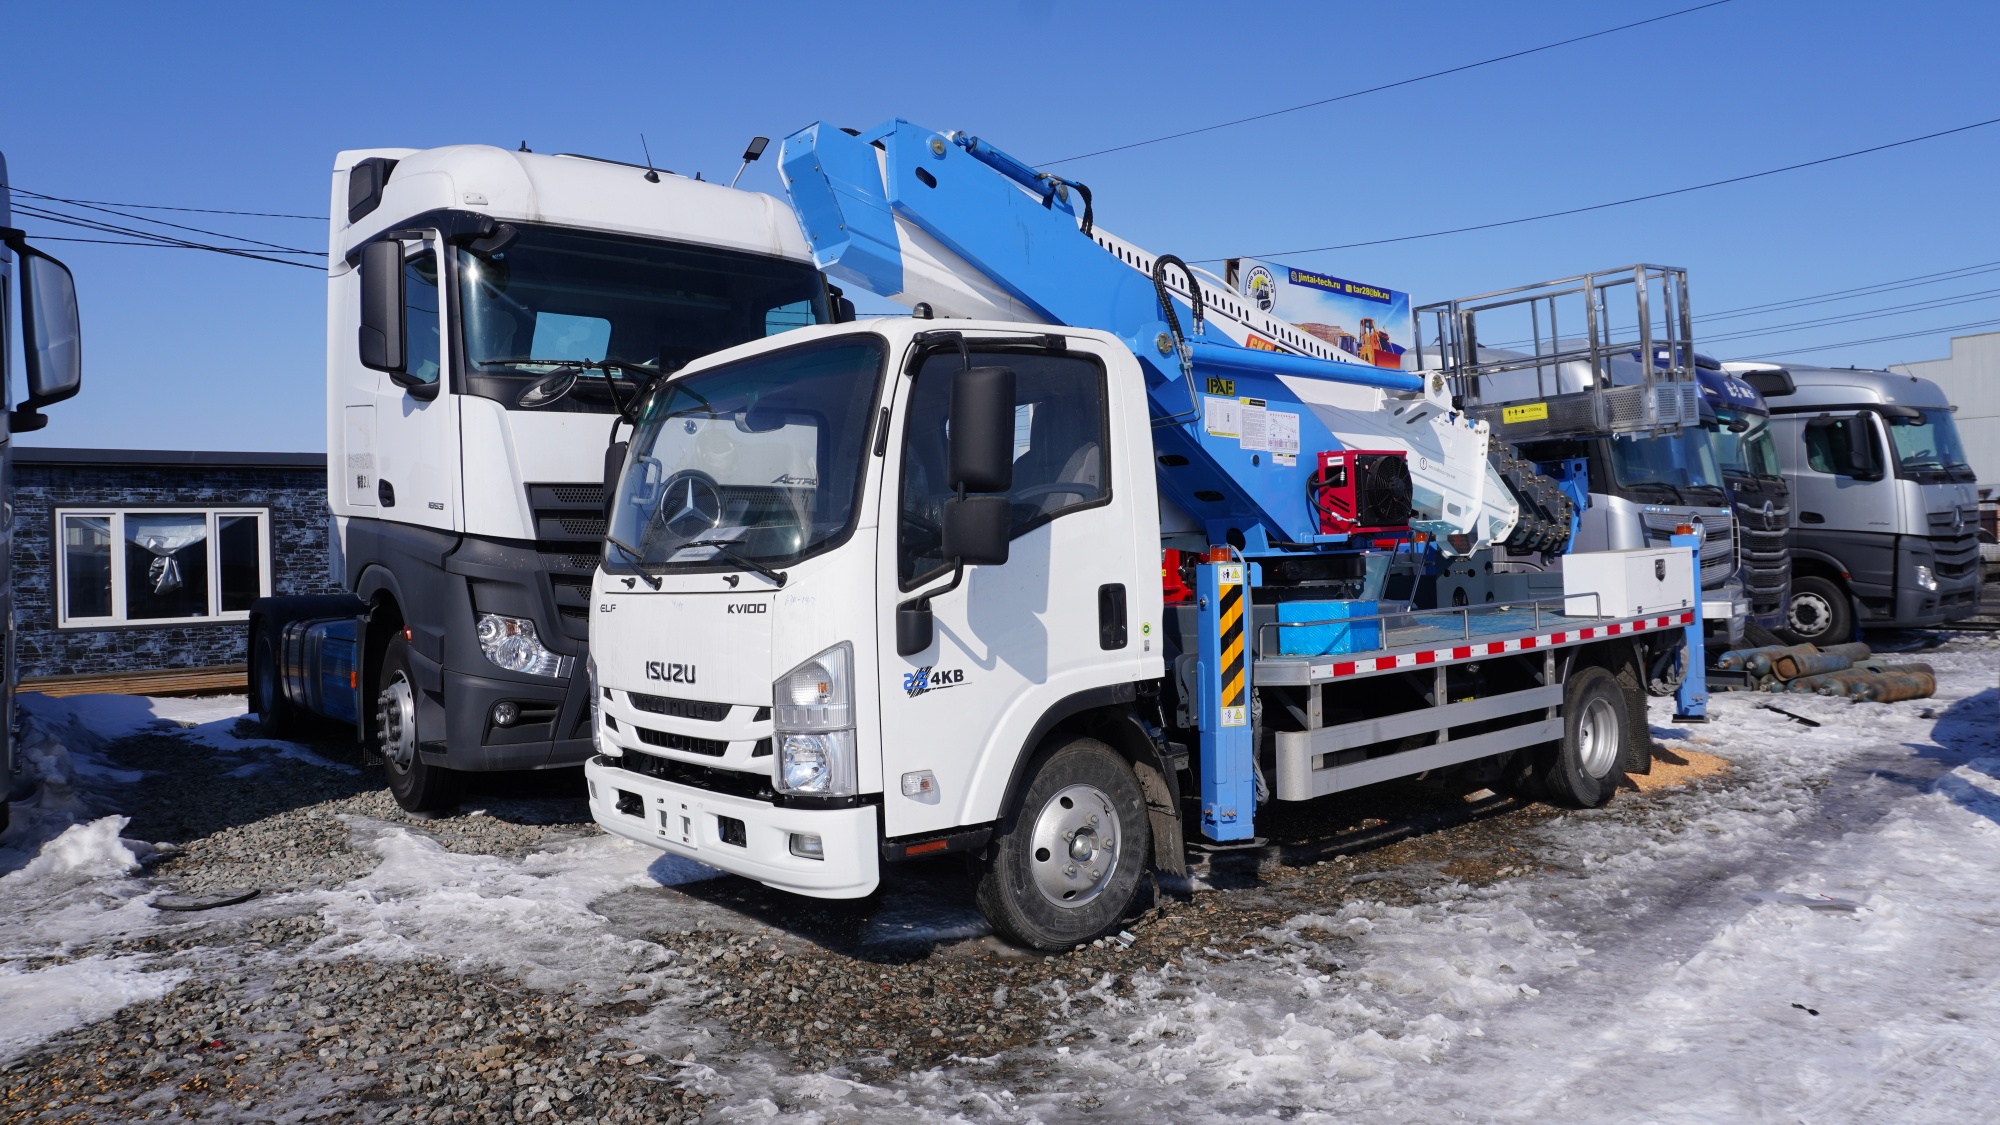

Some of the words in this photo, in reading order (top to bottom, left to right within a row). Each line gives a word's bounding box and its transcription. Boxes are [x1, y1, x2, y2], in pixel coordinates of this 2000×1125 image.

[1298, 272, 1341, 290] jintai-tech.ru
[1353, 285, 1390, 300] tar28@bk.ru
[1206, 374, 1233, 395] IPAF
[771, 473, 817, 486] ACTRO
[600, 603, 617, 613] ELF
[727, 603, 767, 614] KV100
[645, 660, 697, 685] ISUZU
[930, 668, 965, 685] 4KB
